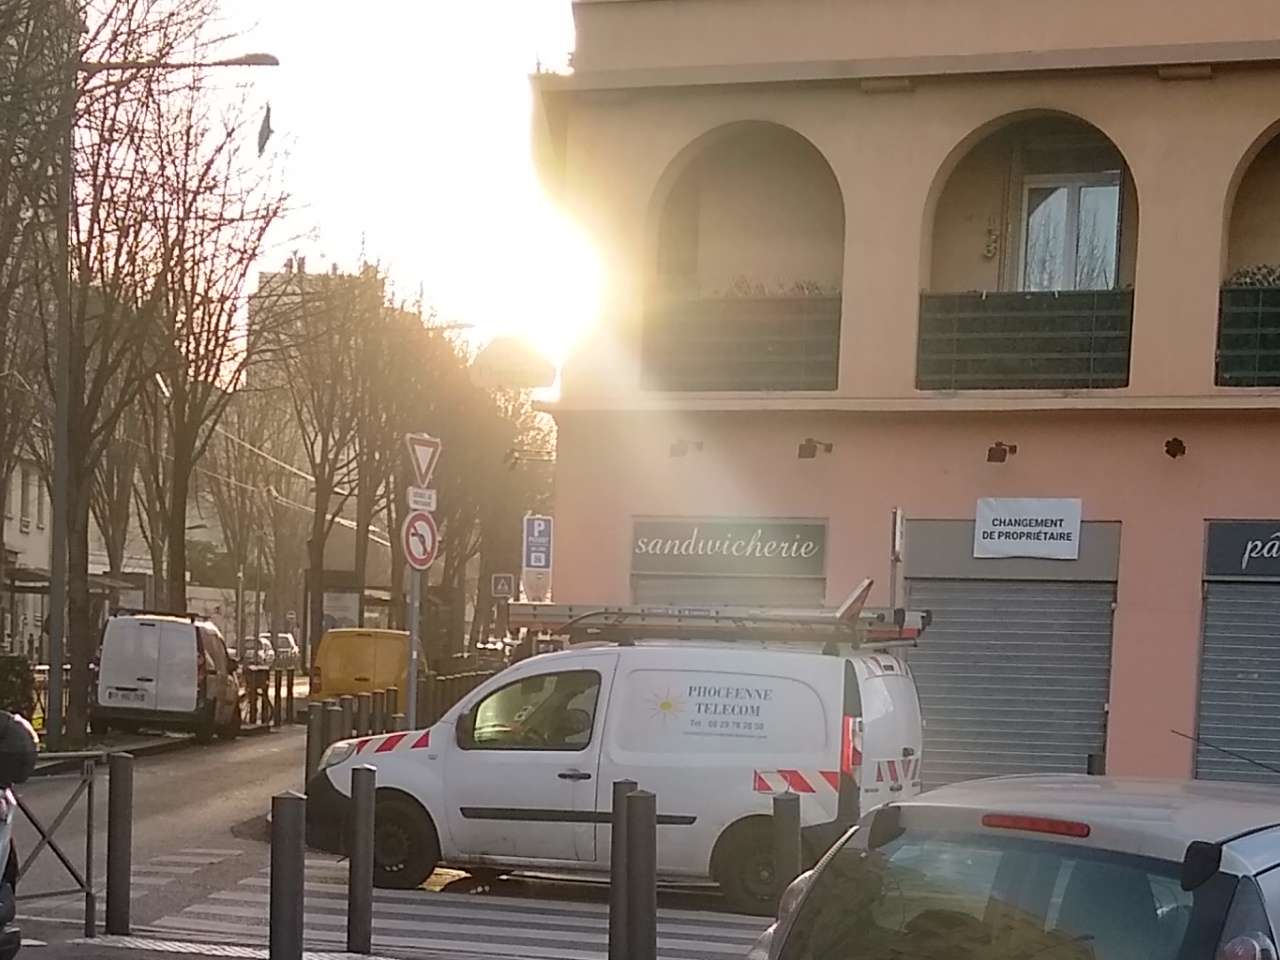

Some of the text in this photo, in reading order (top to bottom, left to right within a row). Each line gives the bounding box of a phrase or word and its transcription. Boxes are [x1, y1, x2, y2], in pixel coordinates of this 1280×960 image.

[992, 518, 1064, 528] CHANGEMENT
[982, 530, 1072, 541] DE PROPRIÉTAIRE
[634, 527, 820, 558] sandwicherie
[696, 702, 761, 717] TELECOM
